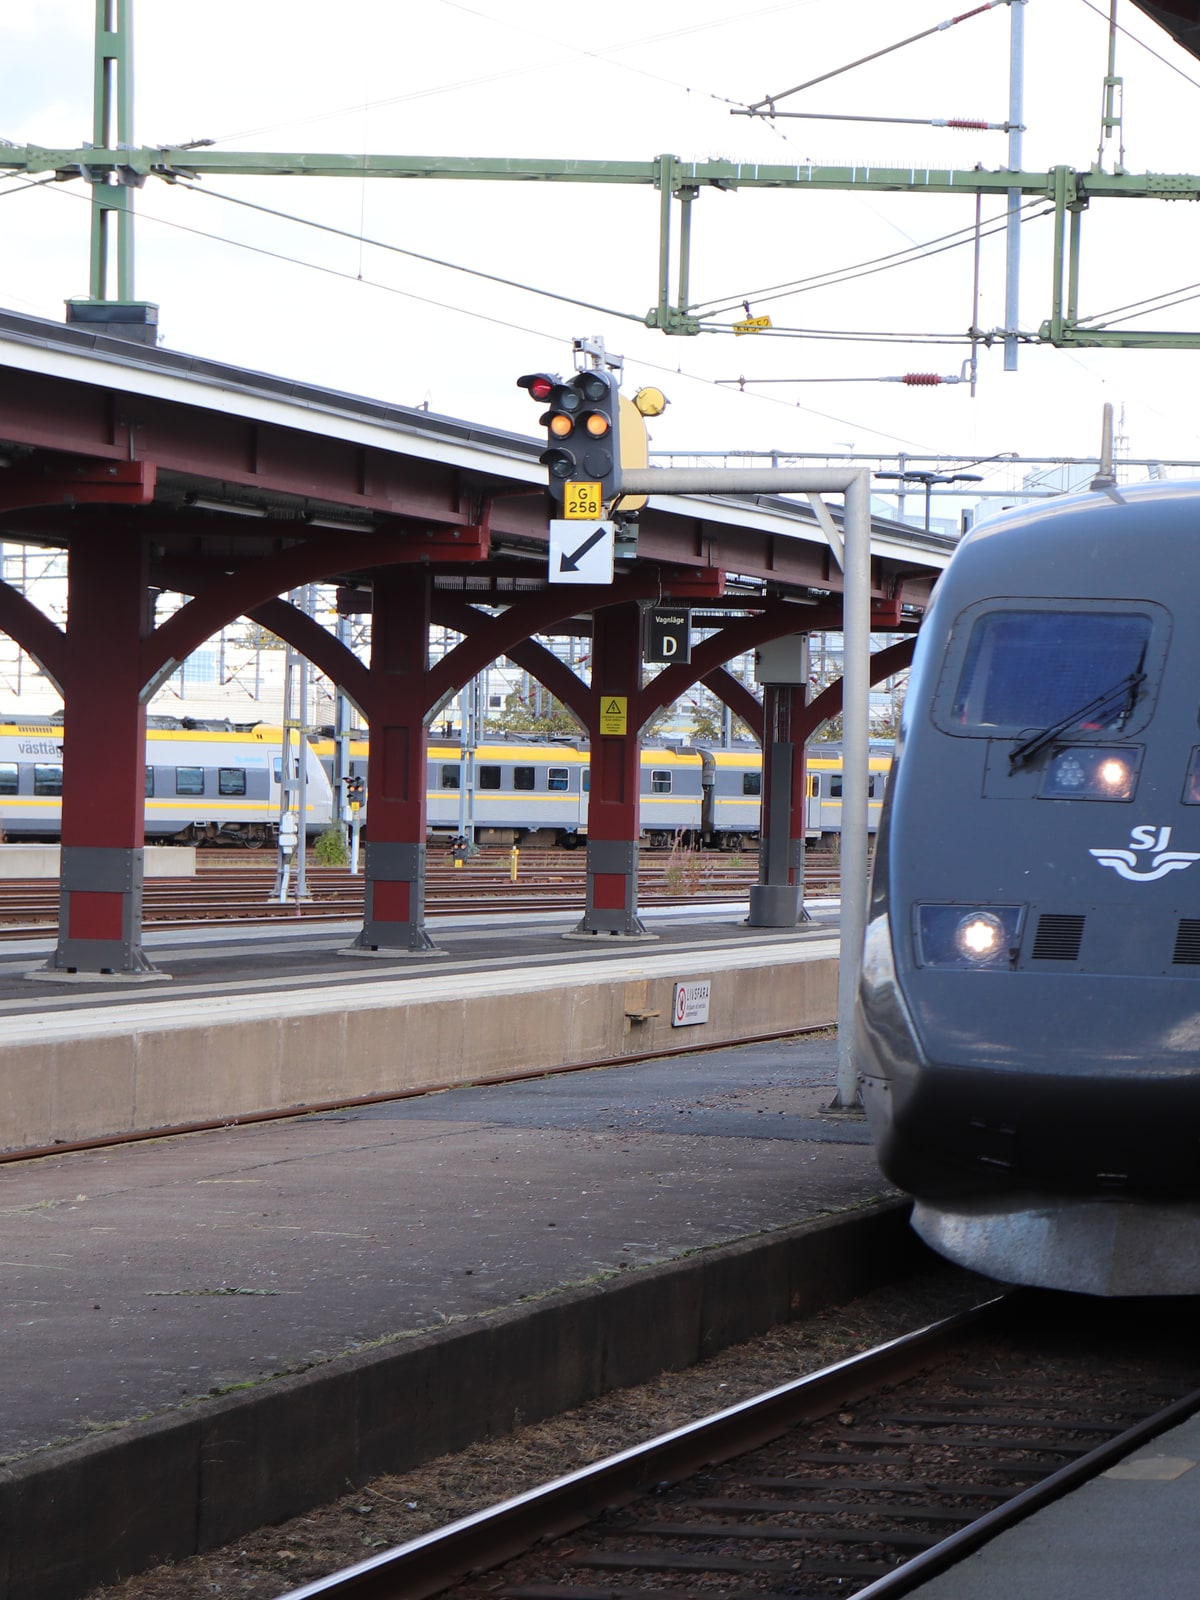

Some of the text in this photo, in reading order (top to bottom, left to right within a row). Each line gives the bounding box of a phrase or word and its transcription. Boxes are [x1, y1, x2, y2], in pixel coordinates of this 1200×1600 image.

[578, 488, 588, 500] G
[568, 501, 597, 513] 258
[655, 615, 685, 625] Vagnläge
[662, 636, 677, 656] D
[1129, 825, 1172, 852] SJ
